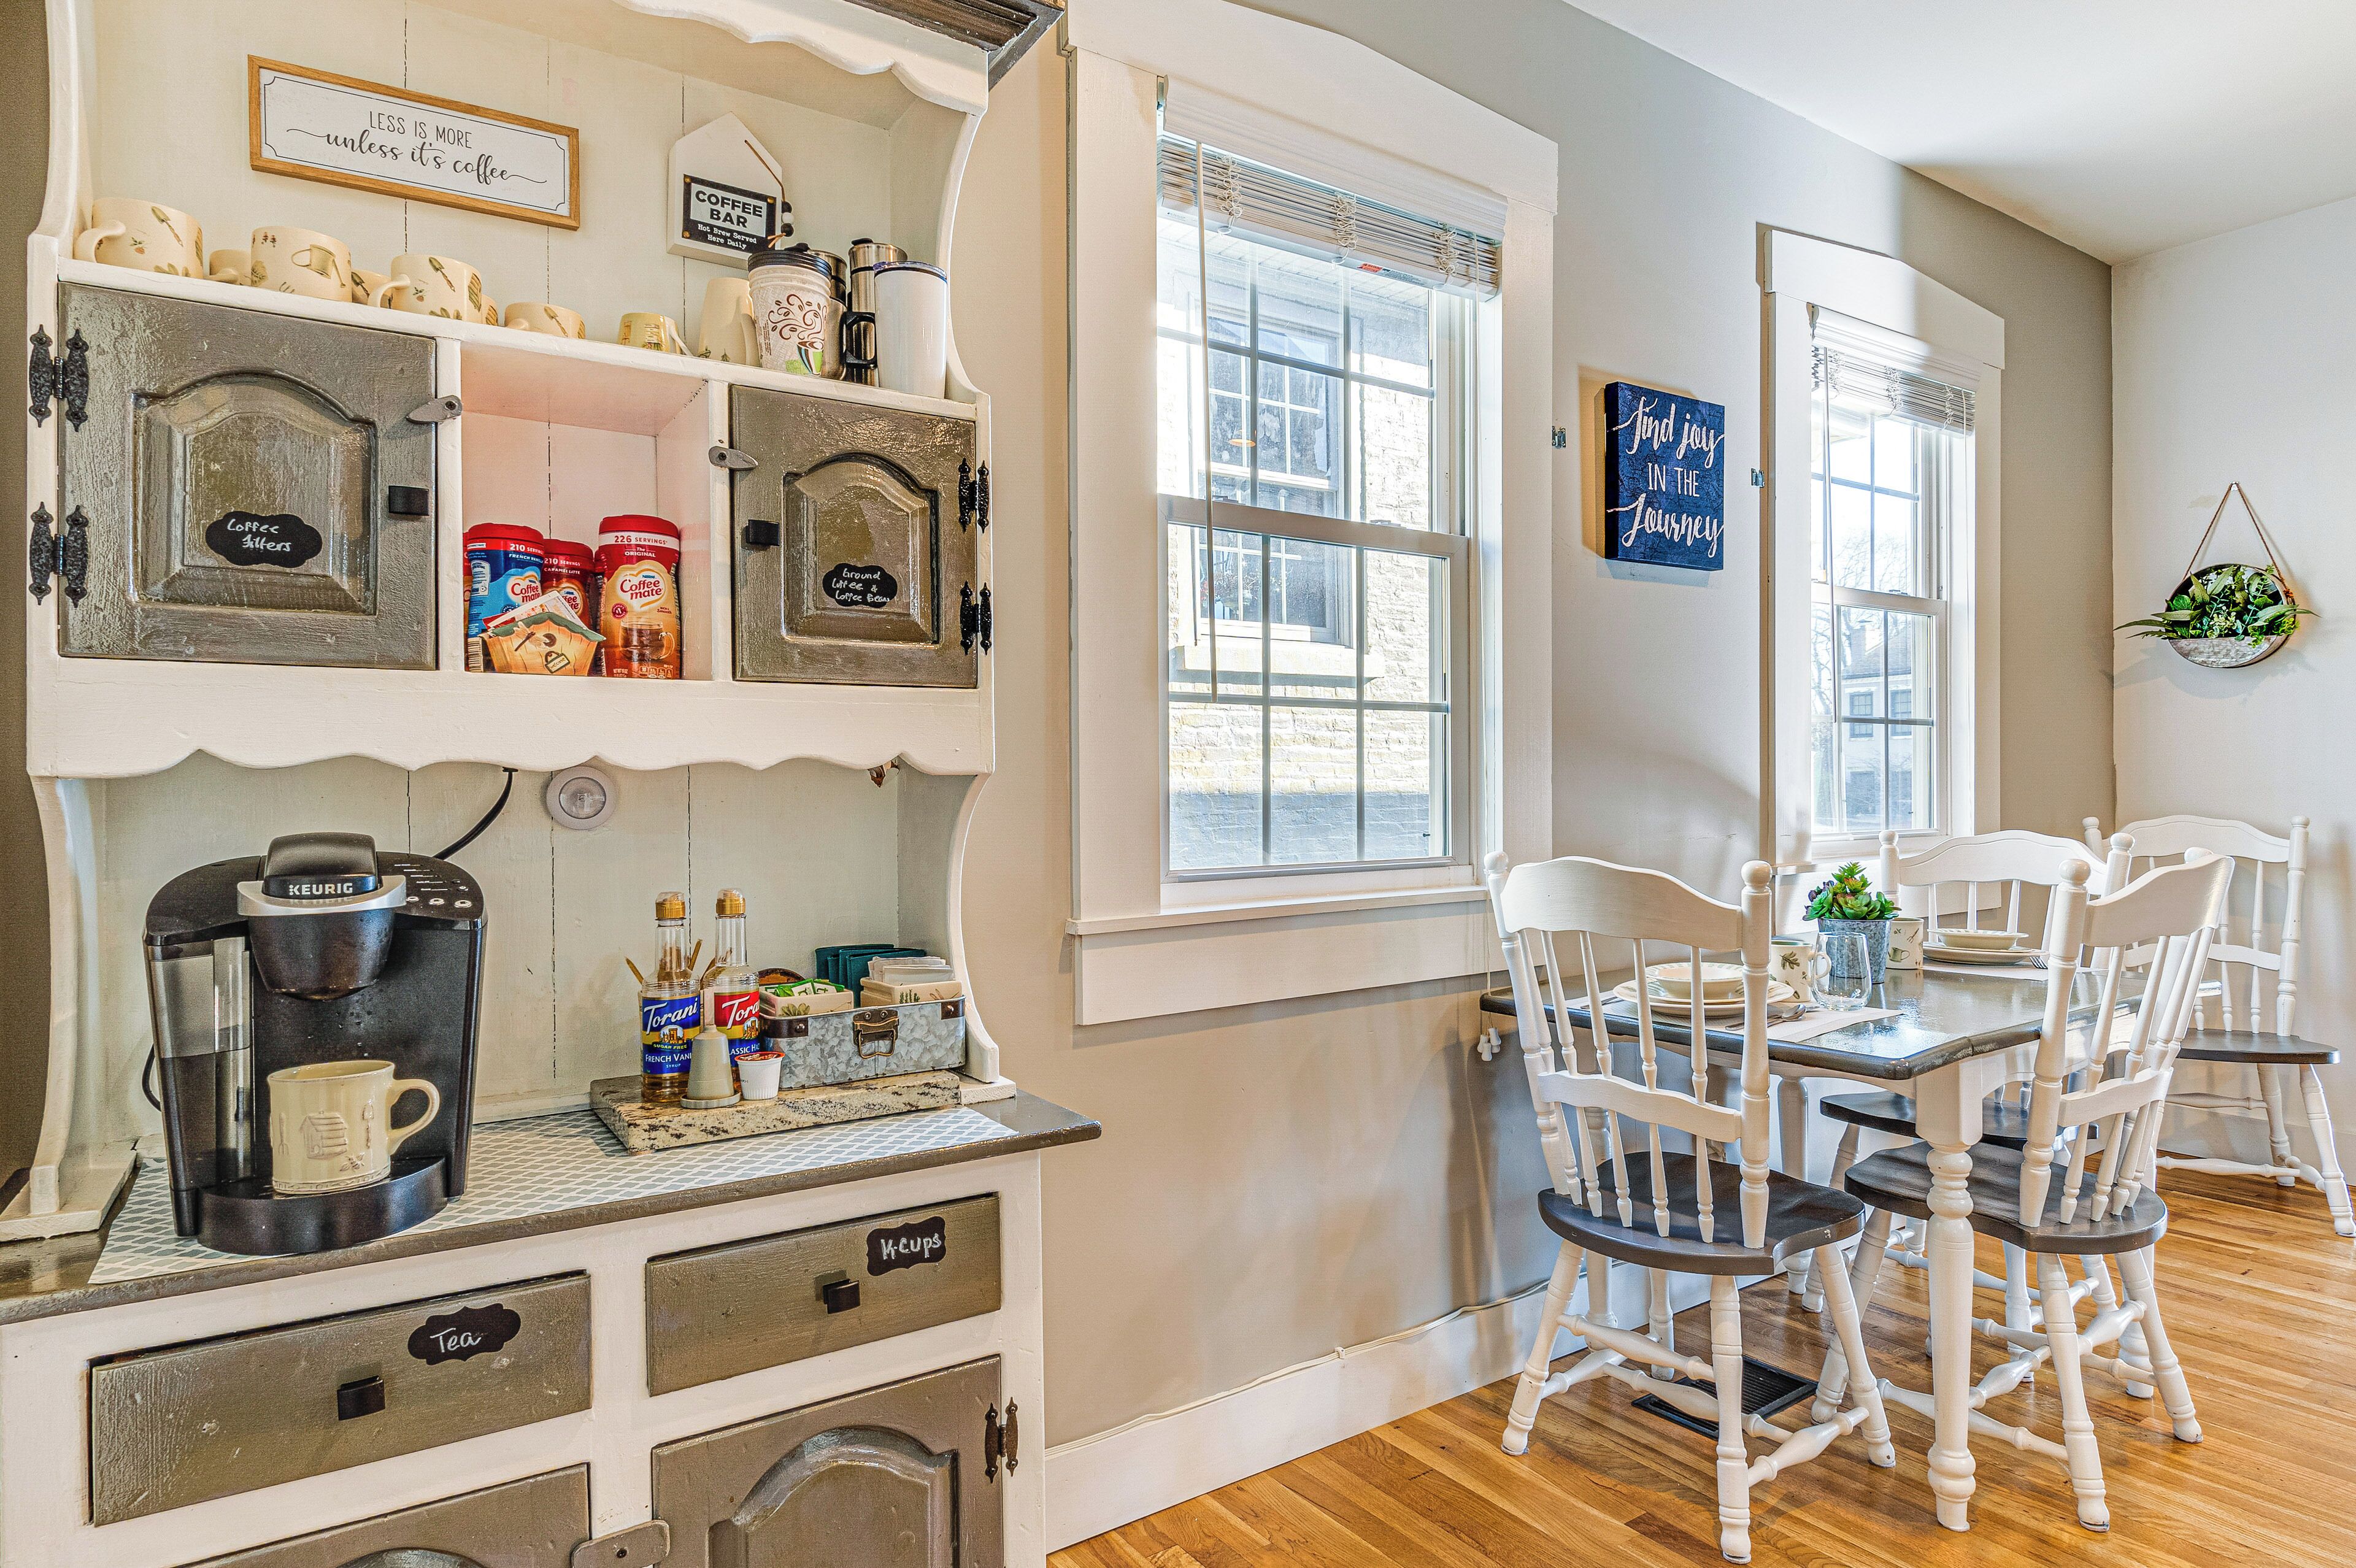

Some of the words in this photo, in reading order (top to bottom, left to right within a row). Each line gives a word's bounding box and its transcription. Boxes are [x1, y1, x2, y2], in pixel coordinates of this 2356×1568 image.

[370, 110, 406, 134] LESS
[415, 120, 427, 139] IS
[436, 125, 472, 149] MORE
[287, 129, 403, 161] unless
[410, 141, 445, 169] it's
[453, 153, 547, 185] coffee
[695, 190, 763, 218] COFFEE
[710, 207, 748, 228] BAR
[698, 223, 710, 232] Hot
[713, 227, 731, 237] Brew
[733, 233, 757, 244] Served
[707, 234, 724, 244] Here
[727, 238, 747, 250] Daily
[1676, 413, 1725, 469] joy
[1648, 462, 1666, 491] IN
[1674, 467, 1700, 497] THE
[227, 518, 279, 534] Coffee
[1609, 493, 1725, 558] Journey
[842, 568, 880, 580] Ground
[510, 583, 539, 596] Coffee
[620, 579, 660, 594] Coffee
[629, 587, 663, 601] mate
[835, 590, 863, 602] Coffee
[288, 883, 353, 896] KEURIG
[644, 997, 698, 1036] Torani
[722, 995, 760, 1030] Tora
[645, 1054, 671, 1063] FRENCH
[673, 1053, 692, 1062] VANI
[429, 1328, 482, 1353] Tea
